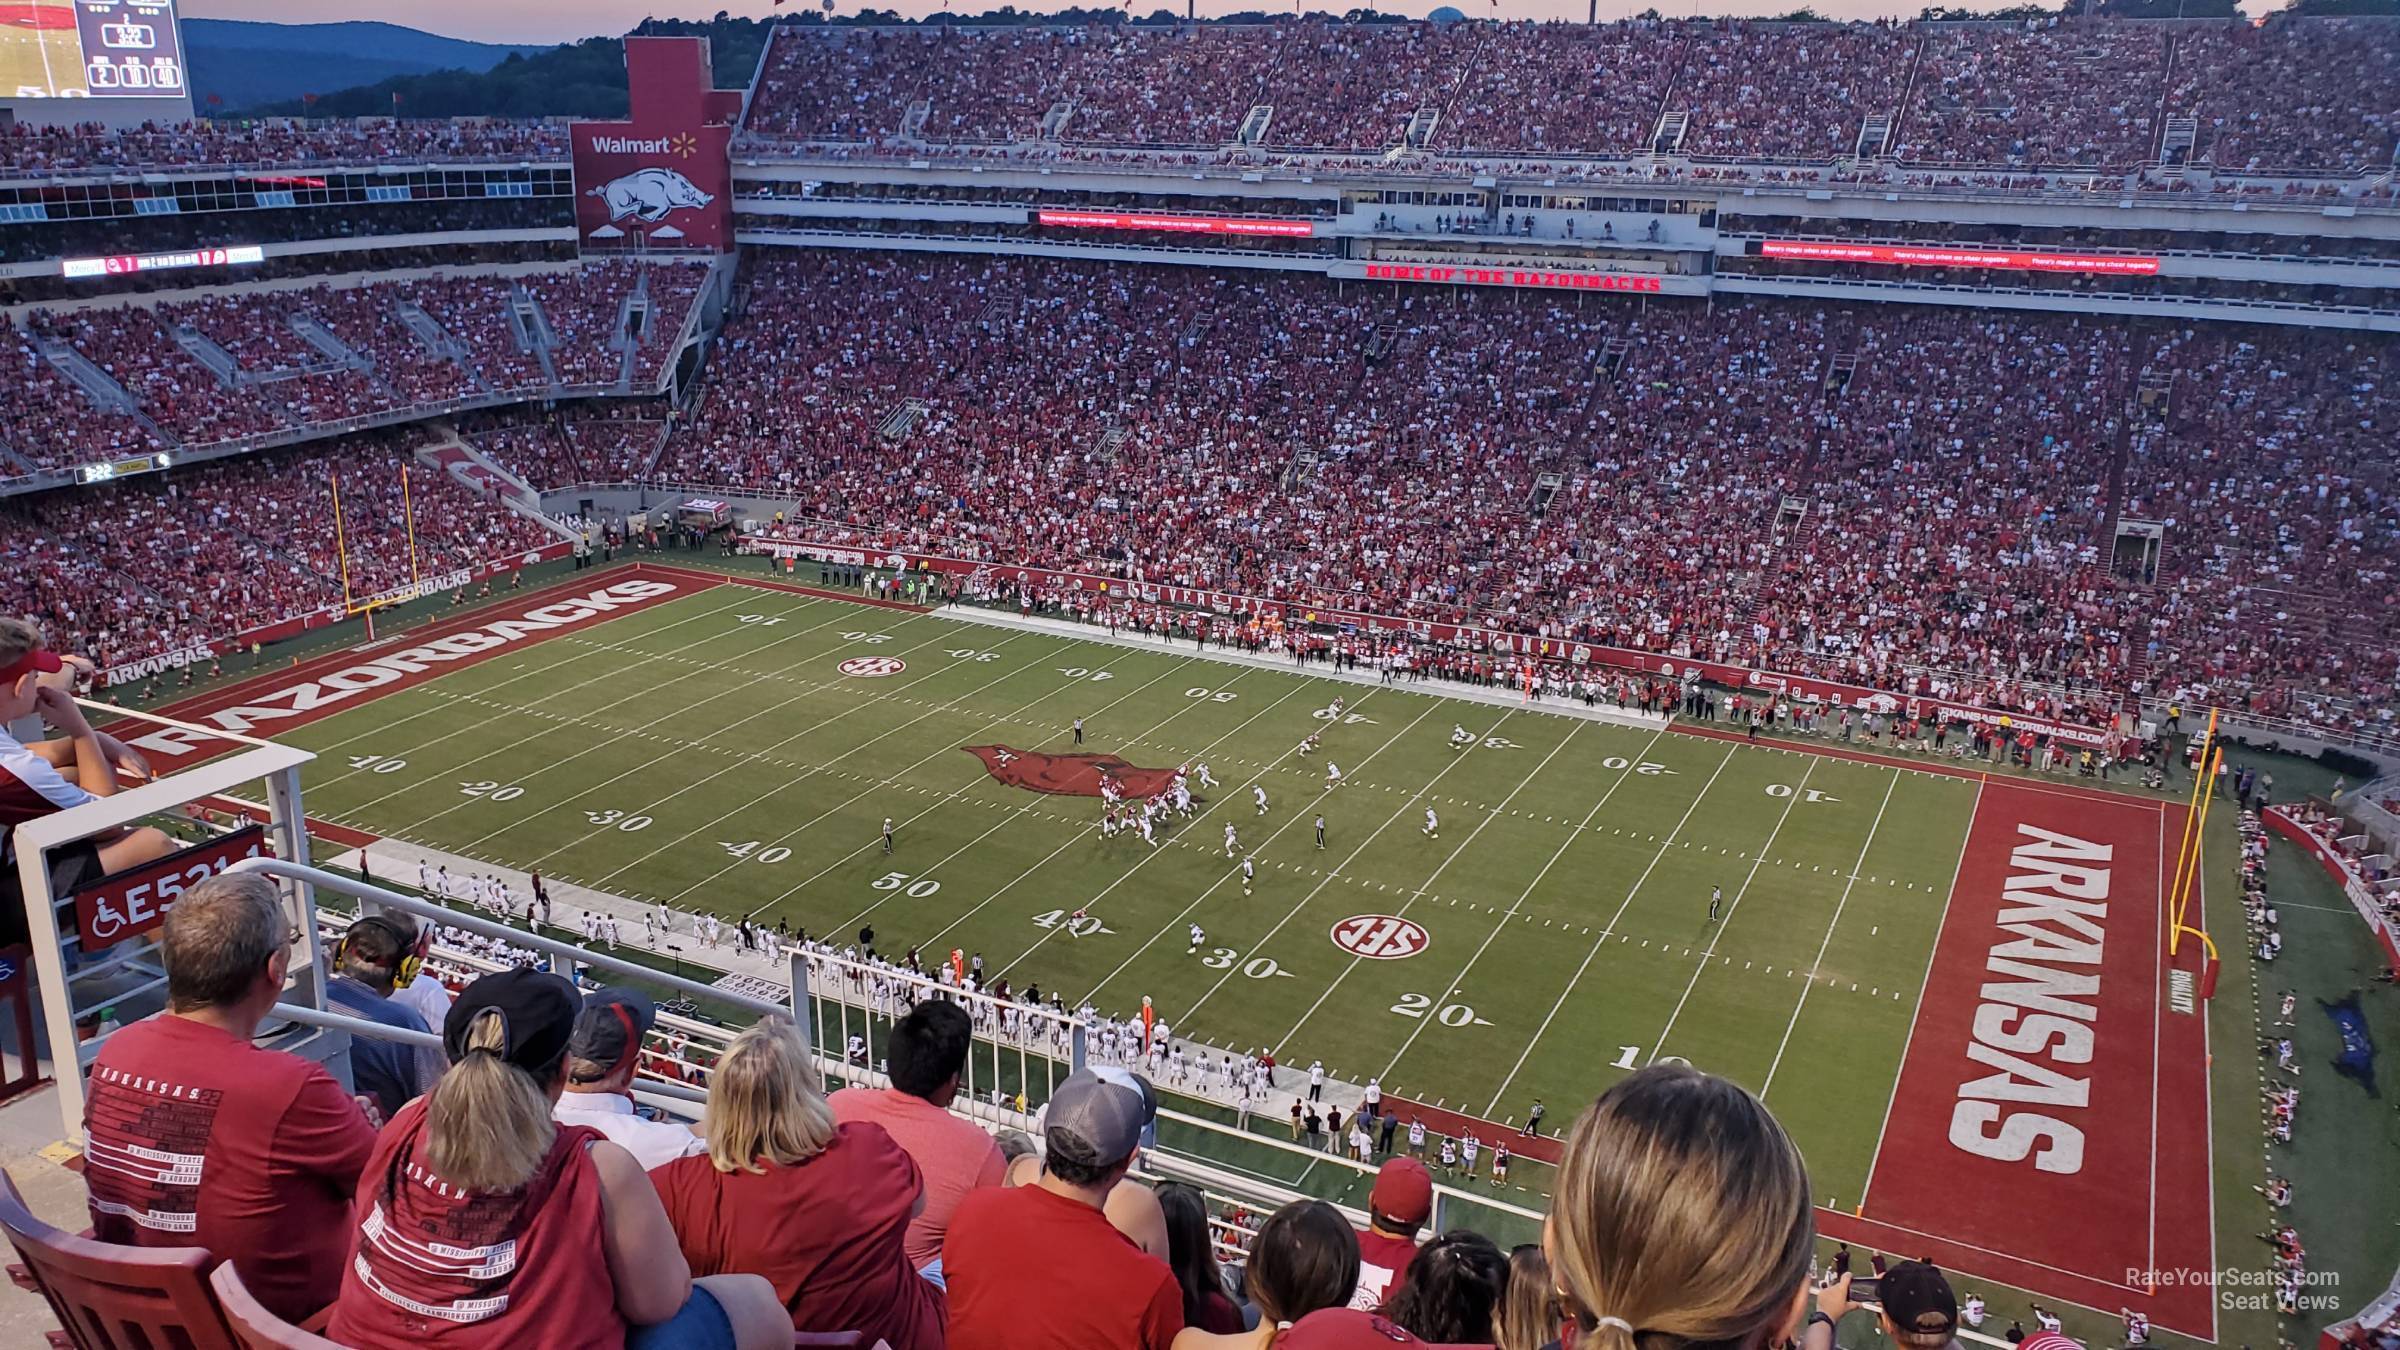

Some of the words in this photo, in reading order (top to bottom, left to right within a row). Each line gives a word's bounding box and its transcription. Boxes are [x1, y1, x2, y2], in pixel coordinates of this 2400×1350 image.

[592, 136, 670, 154] Walmart
[1430, 268, 1457, 282] OF
[1464, 269, 1505, 284] THE
[1514, 272, 1660, 292] RAZORBACKS
[107, 645, 213, 687] ARKANSAS
[127, 579, 678, 756] RAZORBACKS
[1185, 687, 1238, 703] 50
[349, 755, 406, 774] 10
[1602, 757, 1666, 776] 20
[460, 781, 525, 802] 20
[1765, 784, 1826, 803] 10
[588, 809, 653, 832] 30
[724, 841, 792, 864] 40
[871, 871, 941, 898] 50
[1032, 909, 1103, 937] 40
[1338, 917, 1423, 956] SEC
[1202, 948, 1278, 979] 30
[1390, 993, 1475, 1027] 20
[1949, 823, 2113, 1174] ARKANSAS
[101, 1067, 200, 1099] ARKANSAS
[169, 1175, 198, 1183] AUBURN
[404, 1162, 468, 1200] ARKAN
[160, 1213, 194, 1221] MISSOURI
[482, 1264, 514, 1277] AUBURN
[421, 1308, 480, 1321] CHAMPIONSHIP
[467, 1297, 507, 1309] MISSOURI
